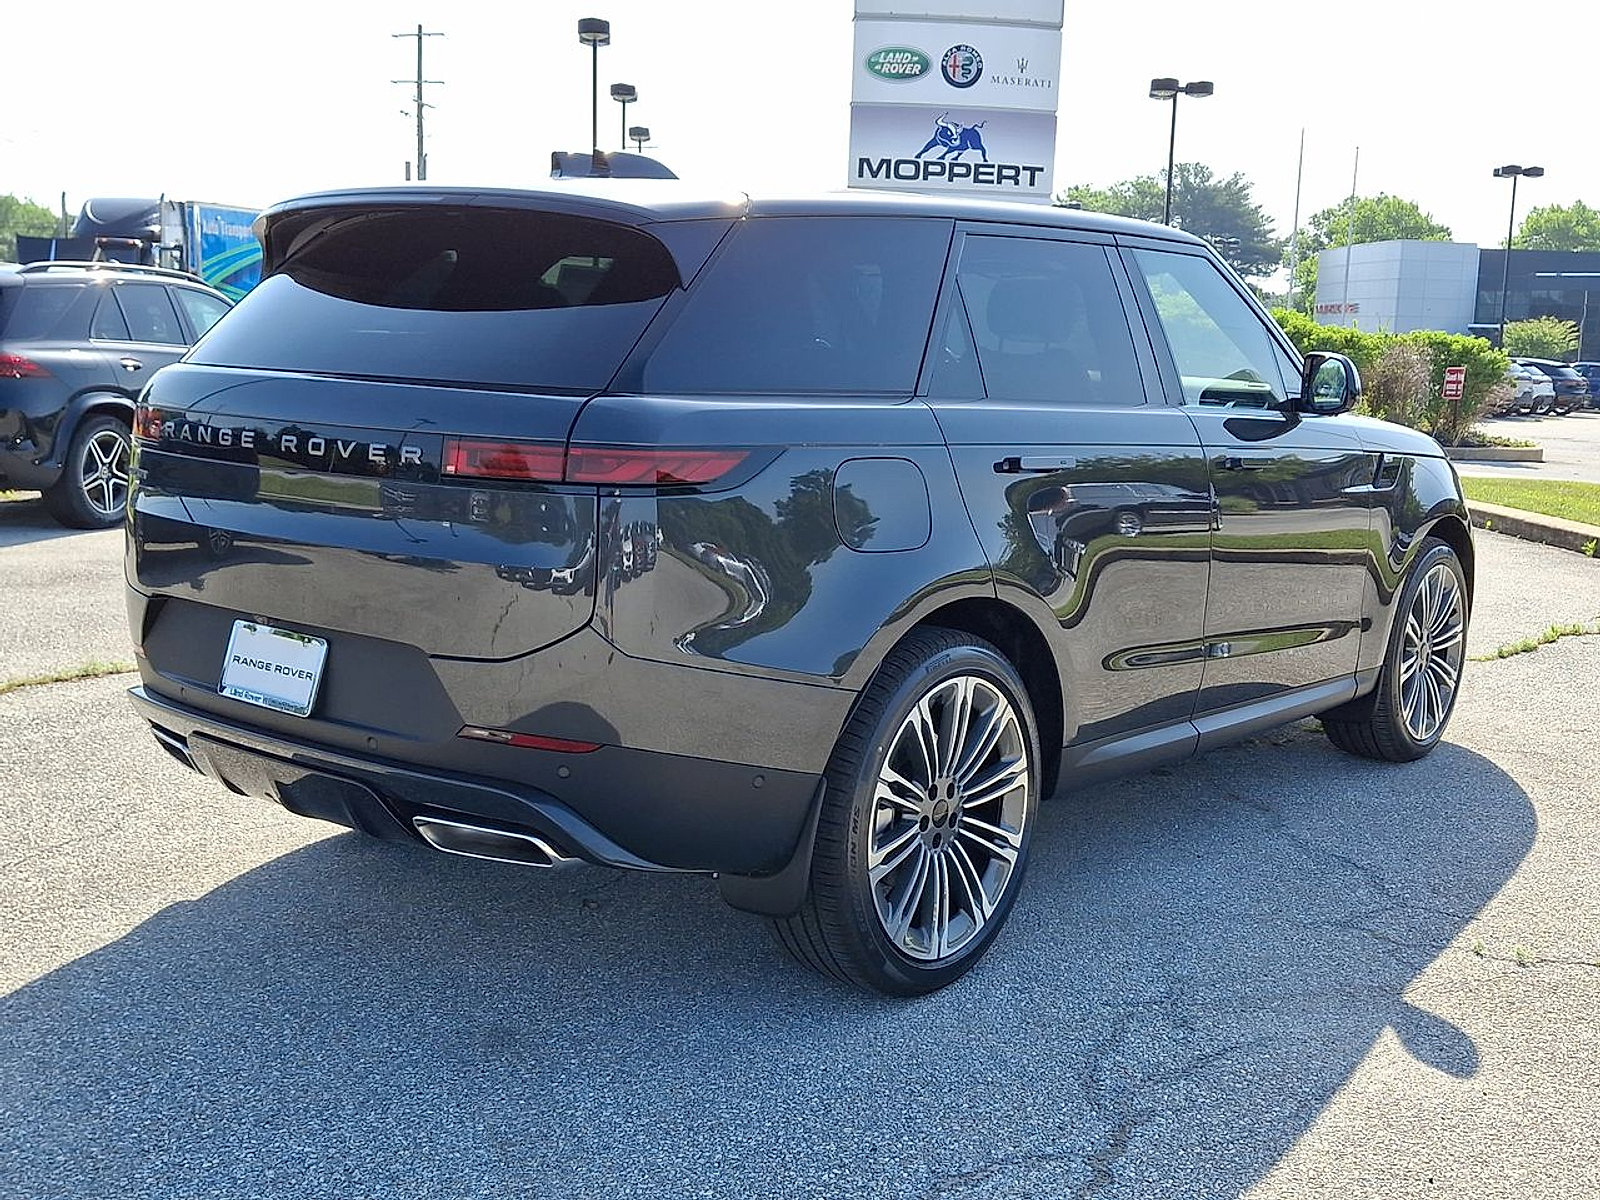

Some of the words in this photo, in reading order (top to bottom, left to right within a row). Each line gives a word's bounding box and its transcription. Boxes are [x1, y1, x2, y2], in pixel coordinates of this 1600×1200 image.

[879, 51, 912, 63] LAND
[881, 63, 921, 75] ROVER
[990, 75, 1052, 89] MASERATI
[857, 157, 1045, 187] MOPPERT
[163, 420, 255, 449] RANGE
[280, 433, 424, 466] ROVER
[232, 654, 273, 672] RANGE
[273, 664, 314, 681] ROVER
